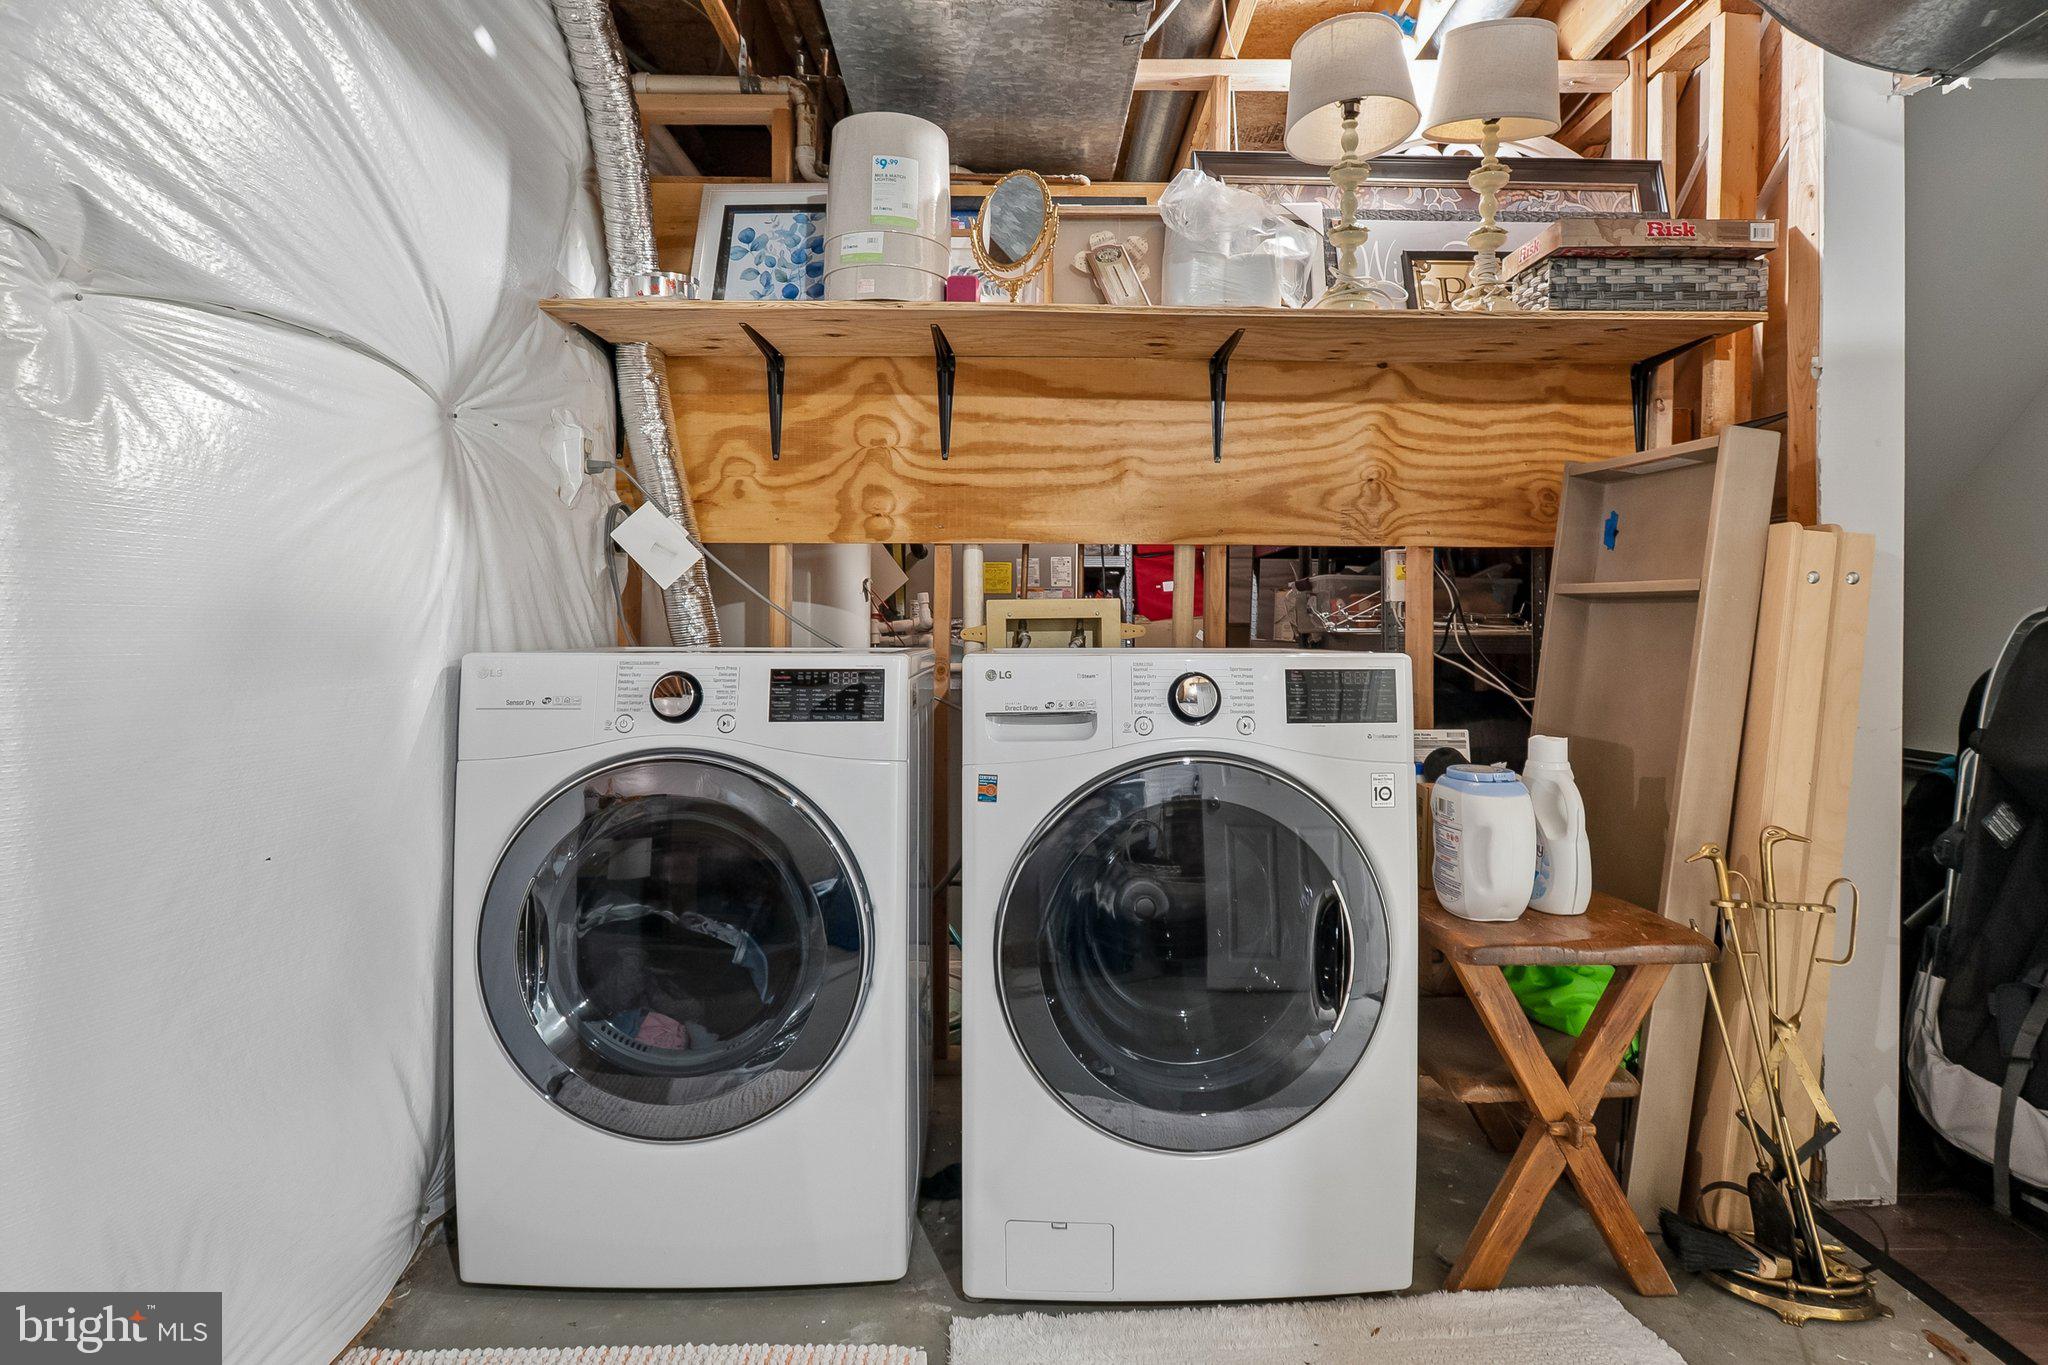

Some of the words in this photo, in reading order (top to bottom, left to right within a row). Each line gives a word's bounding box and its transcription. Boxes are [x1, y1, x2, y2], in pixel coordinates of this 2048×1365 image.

[874, 157, 899, 169] $9.99
[1646, 221, 1696, 237] Risk
[1518, 239, 1541, 263] Risk
[489, 669, 503, 677] LG
[999, 670, 1012, 679] LG
[1373, 786, 1392, 801] 10
